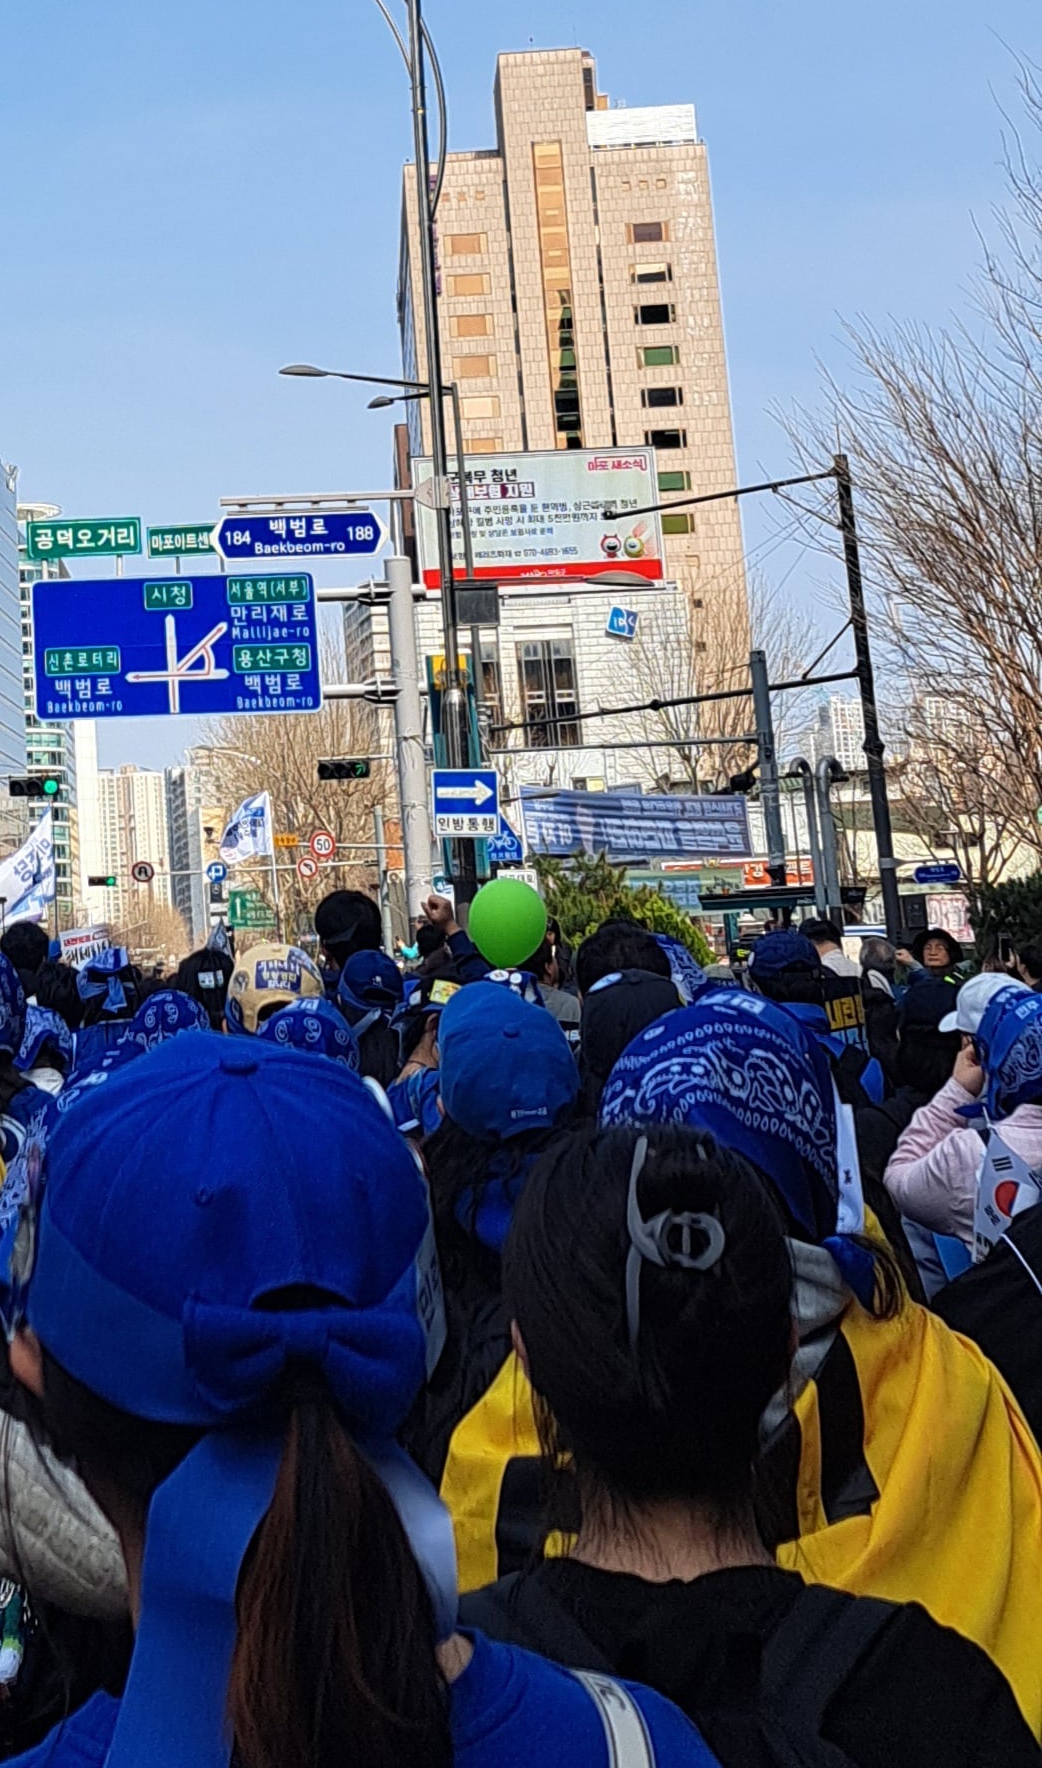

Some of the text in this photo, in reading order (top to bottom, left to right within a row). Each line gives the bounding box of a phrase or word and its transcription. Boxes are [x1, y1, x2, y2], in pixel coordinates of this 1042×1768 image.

[491, 468, 518, 483] 청년
[505, 483, 534, 499] 지원
[269, 518, 329, 535] 백범로
[346, 526, 374, 541] 188
[35, 526, 135, 550] 공덕오거리
[225, 531, 251, 546] 184
[254, 540, 346, 555] Baekbeom-ro
[151, 585, 187, 605] 시청
[230, 578, 308, 601] 서울역(서부)
[230, 605, 309, 627] 만리재로
[231, 626, 310, 640] Mallijae-ro
[48, 651, 118, 672] 신촌로터리
[238, 648, 307, 669] 용산구청
[54, 678, 113, 698] 백범로
[244, 674, 304, 692] 백범로
[47, 699, 123, 714] Baekbeom-ro
[237, 695, 314, 709] Baekbeom-ro
[437, 816, 495, 832] 일방통행
[316, 838, 330, 852] 50
